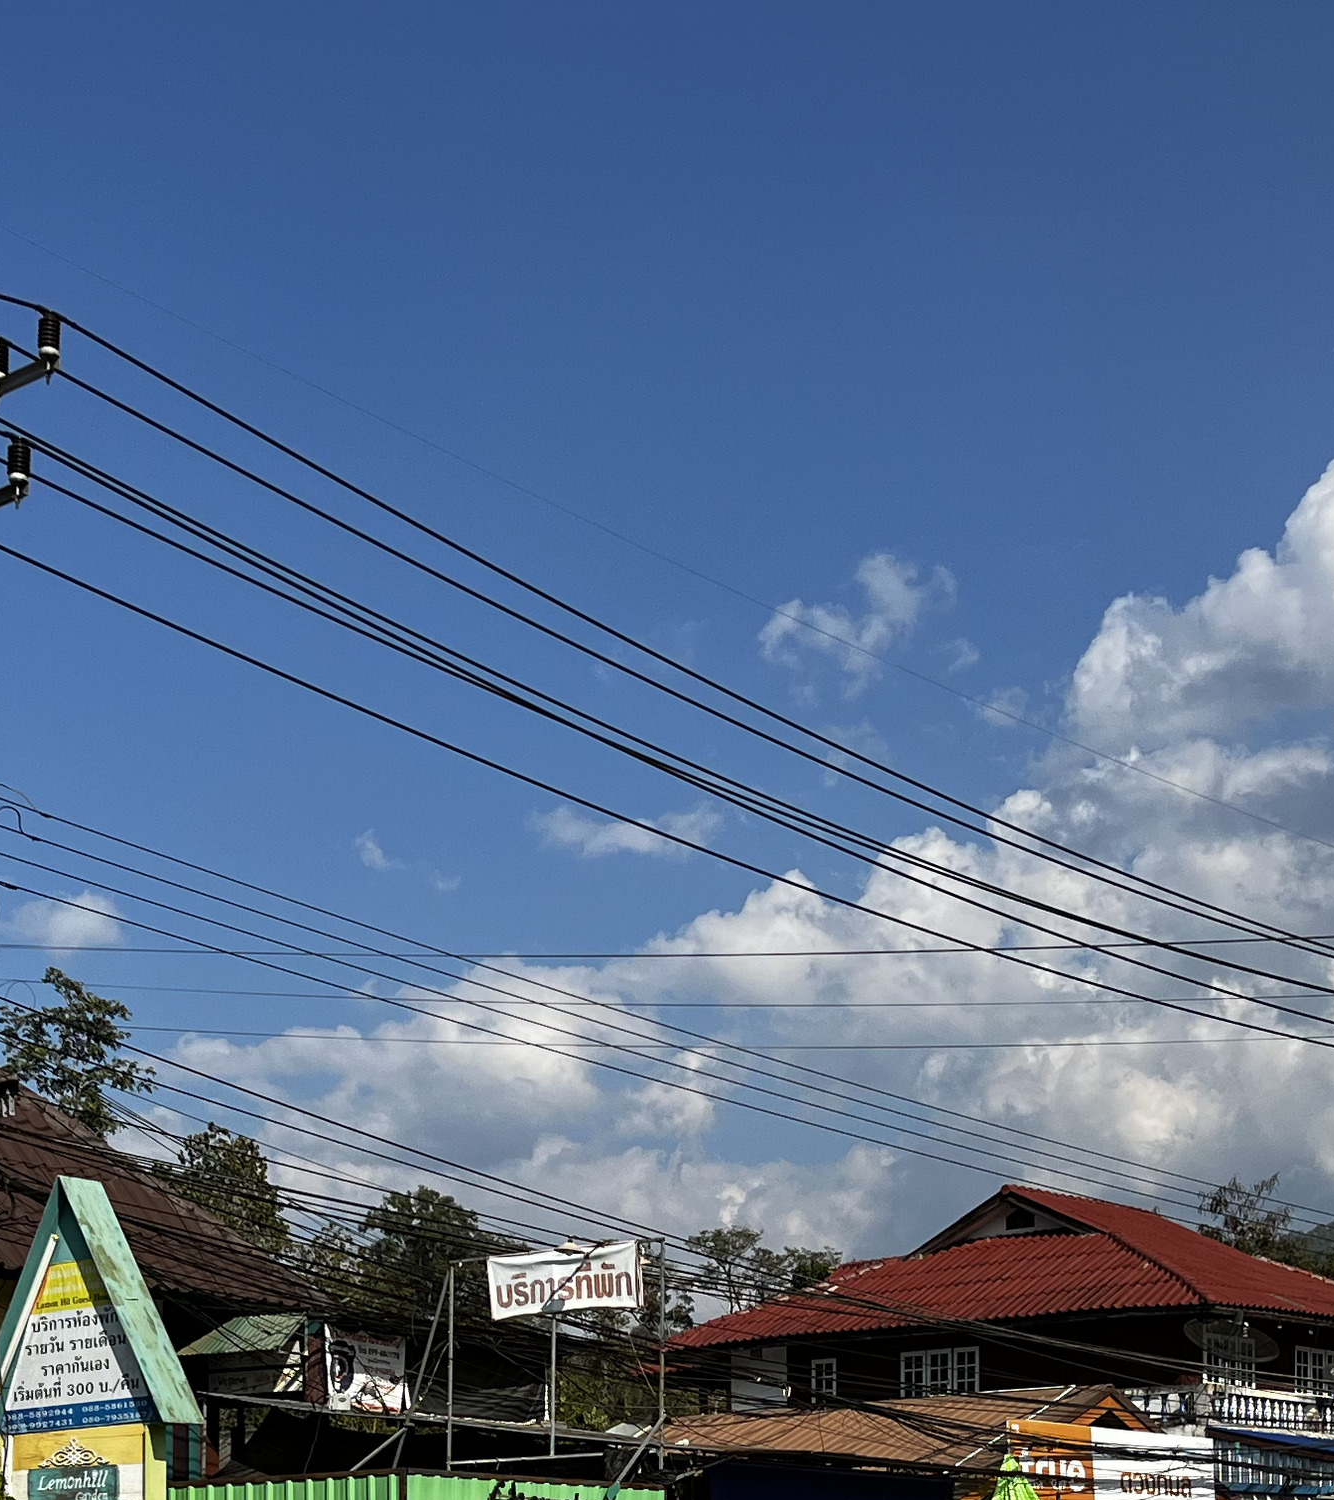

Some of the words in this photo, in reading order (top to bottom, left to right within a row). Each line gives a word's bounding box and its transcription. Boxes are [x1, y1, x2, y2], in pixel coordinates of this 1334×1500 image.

[24, 1336, 65, 1357] รายวัน
[69, 1330, 127, 1350] รายเดือน
[41, 1356, 111, 1377] ราคากันเอง
[13, 1377, 62, 1403] เริ่มต้นที่
[66, 1385, 95, 1397] 300
[37, 1469, 109, 1491] Lemonhill
